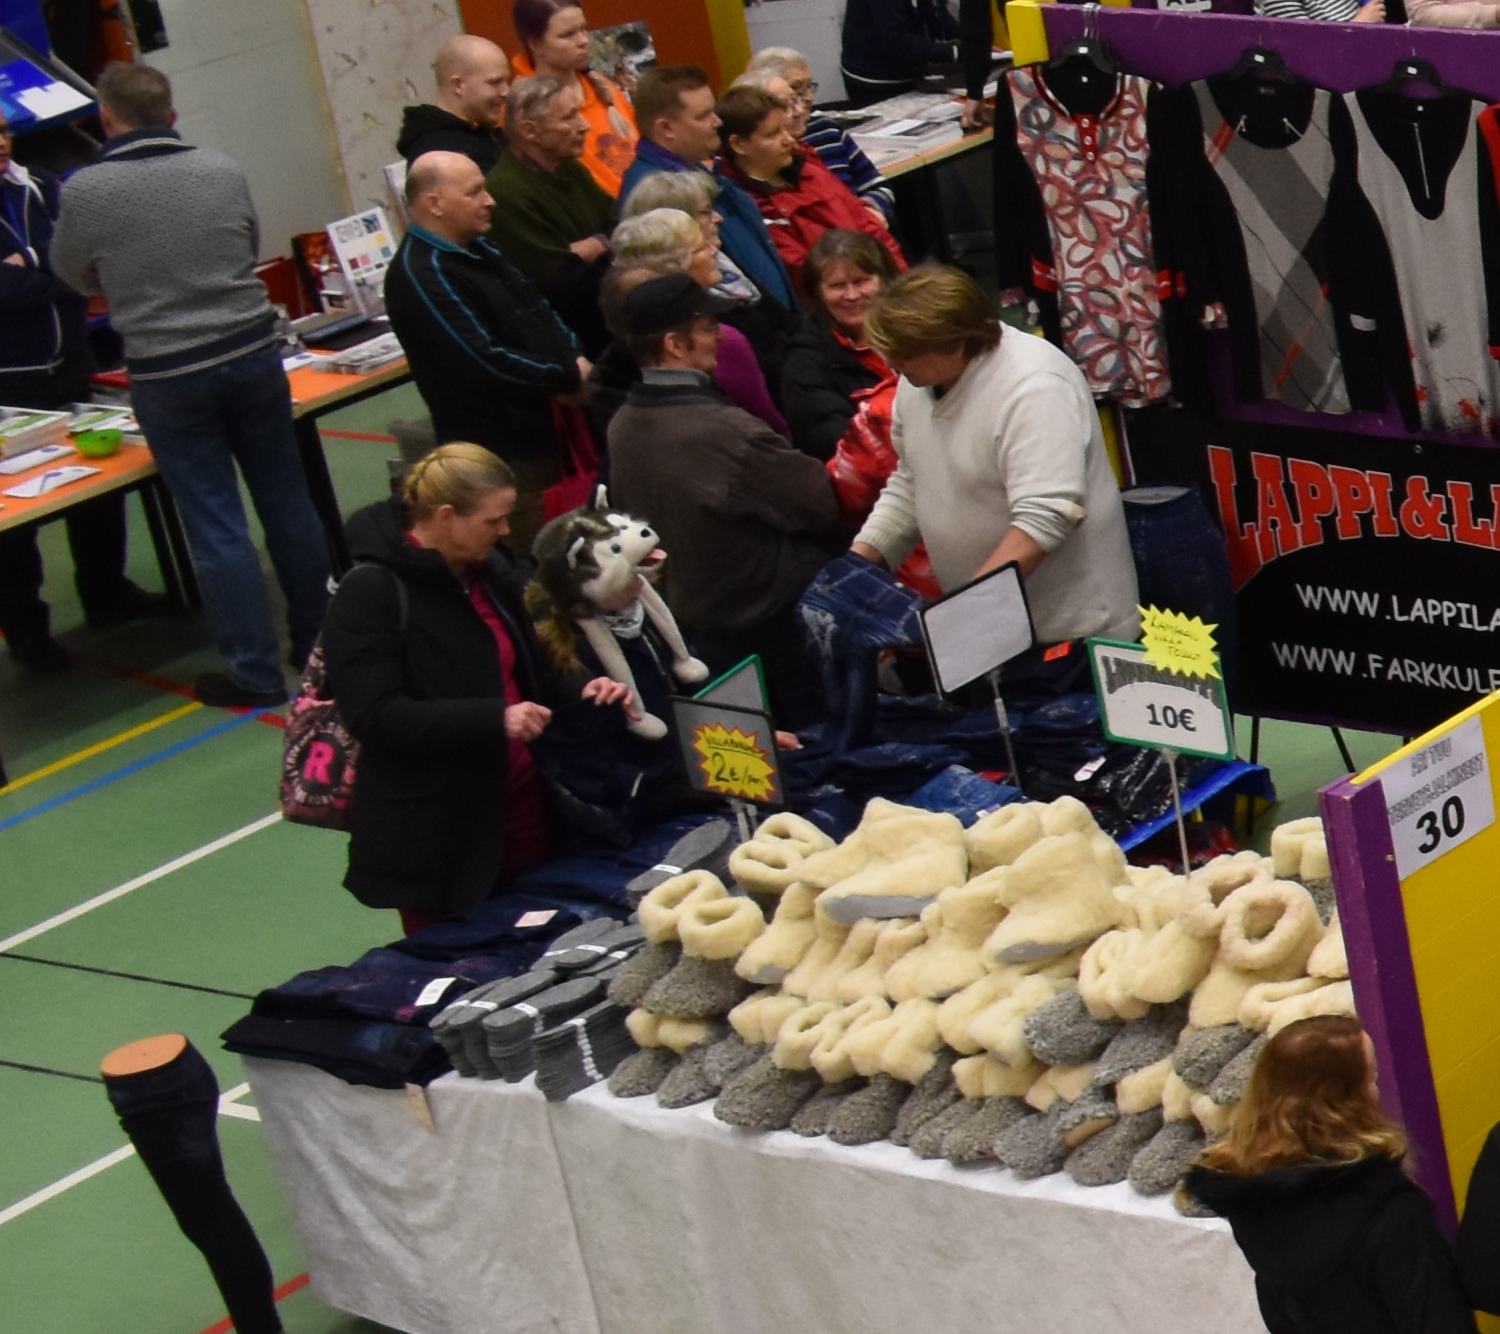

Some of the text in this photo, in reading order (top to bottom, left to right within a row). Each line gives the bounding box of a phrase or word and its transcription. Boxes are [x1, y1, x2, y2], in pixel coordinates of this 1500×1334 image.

[1146, 703, 1197, 732] 10€
[303, 739, 336, 784] R
[1416, 795, 1465, 854] 30
